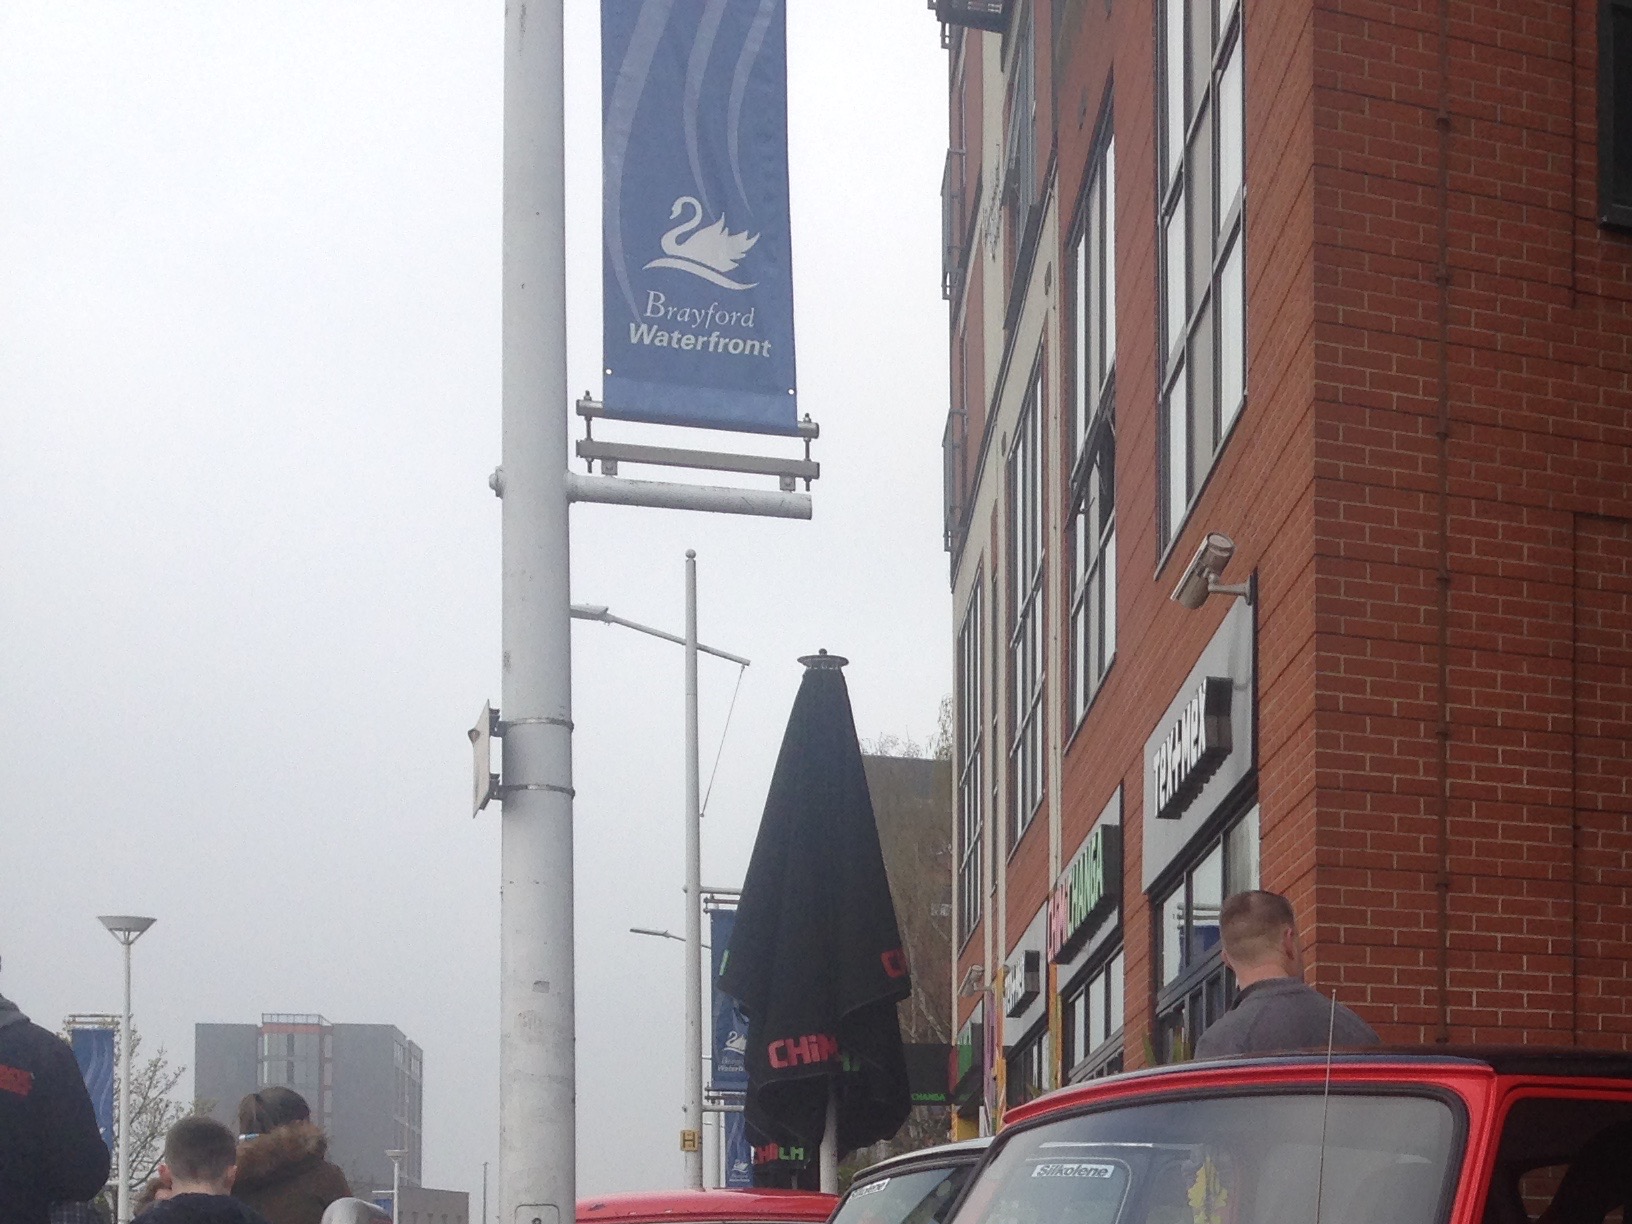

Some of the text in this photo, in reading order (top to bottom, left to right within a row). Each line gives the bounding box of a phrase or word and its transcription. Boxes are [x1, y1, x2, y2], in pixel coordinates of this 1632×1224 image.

[644, 290, 755, 329] Brayford
[628, 322, 772, 358] Waterfront
[1037, 1164, 1109, 1178] Silkolene
